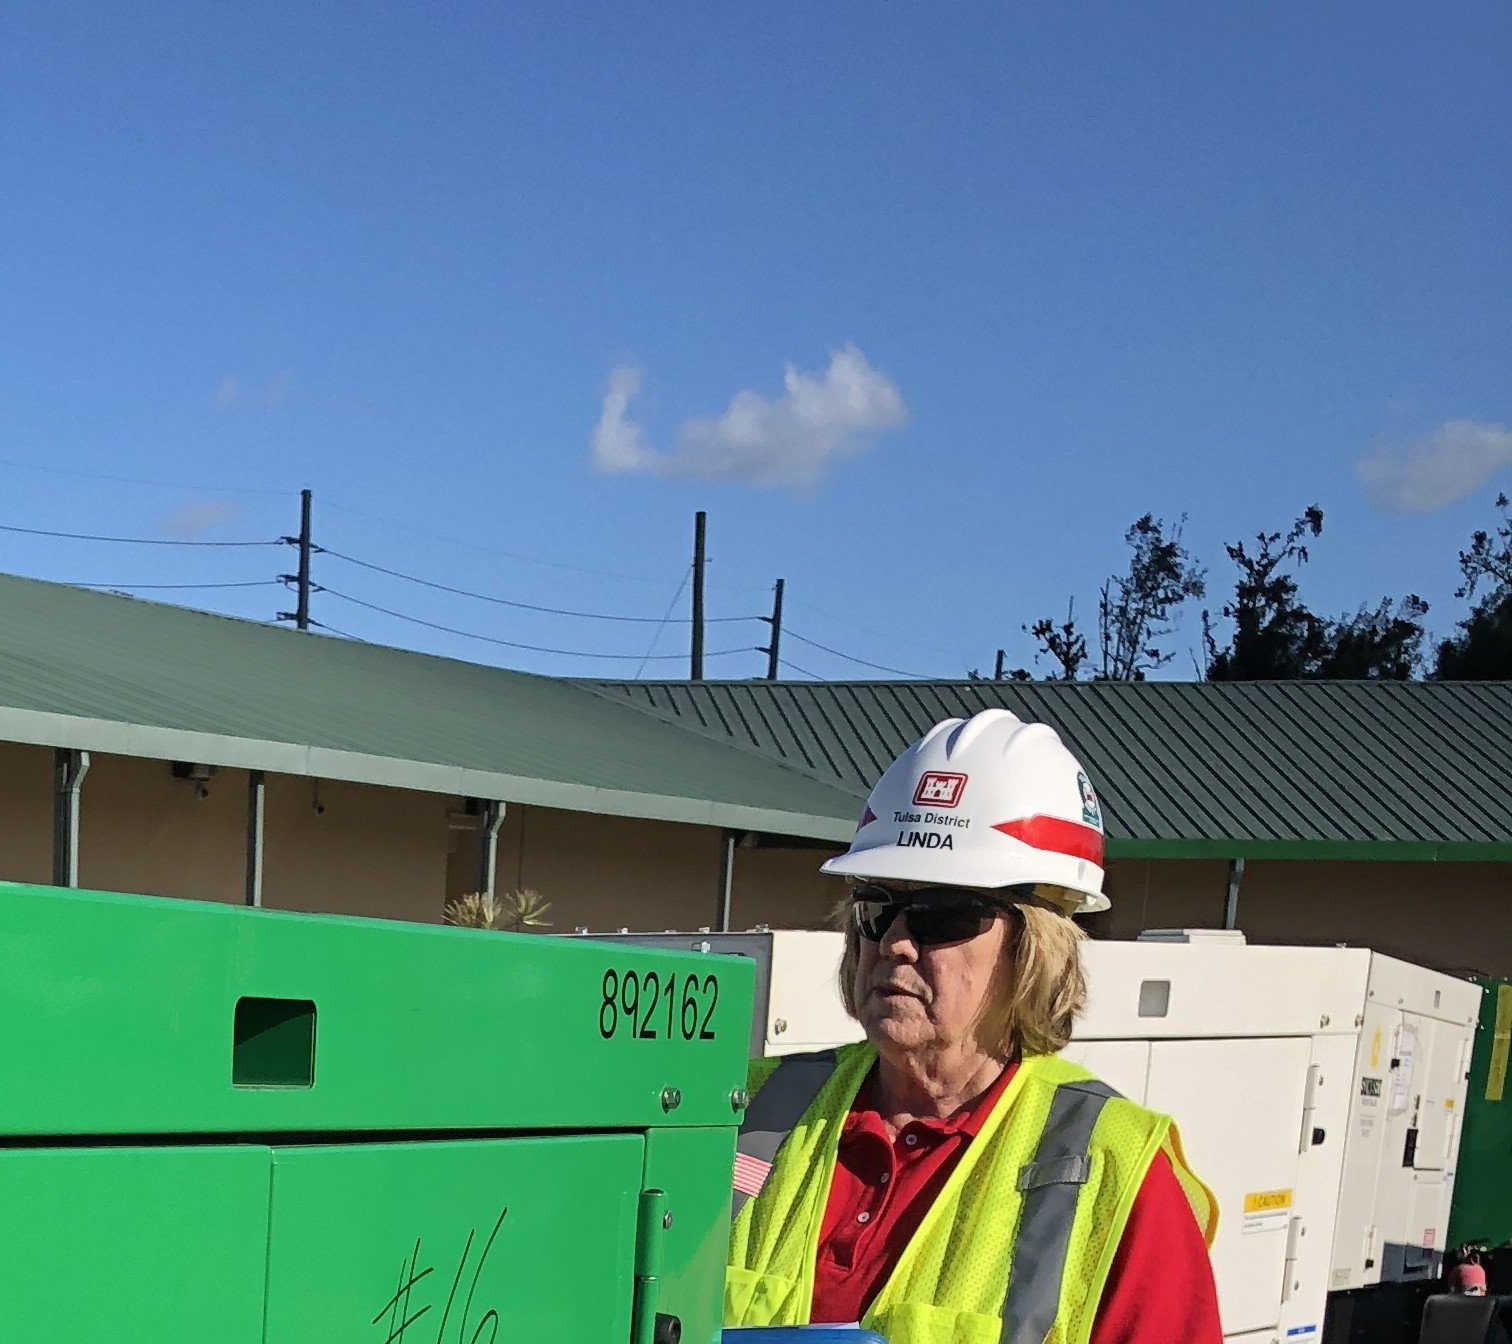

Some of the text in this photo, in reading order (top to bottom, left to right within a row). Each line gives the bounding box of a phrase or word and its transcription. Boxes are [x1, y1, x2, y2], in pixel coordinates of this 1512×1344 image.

[893, 811, 971, 829] Tulsa District
[896, 830, 954, 851] LINDA
[599, 968, 719, 1041] 892162
